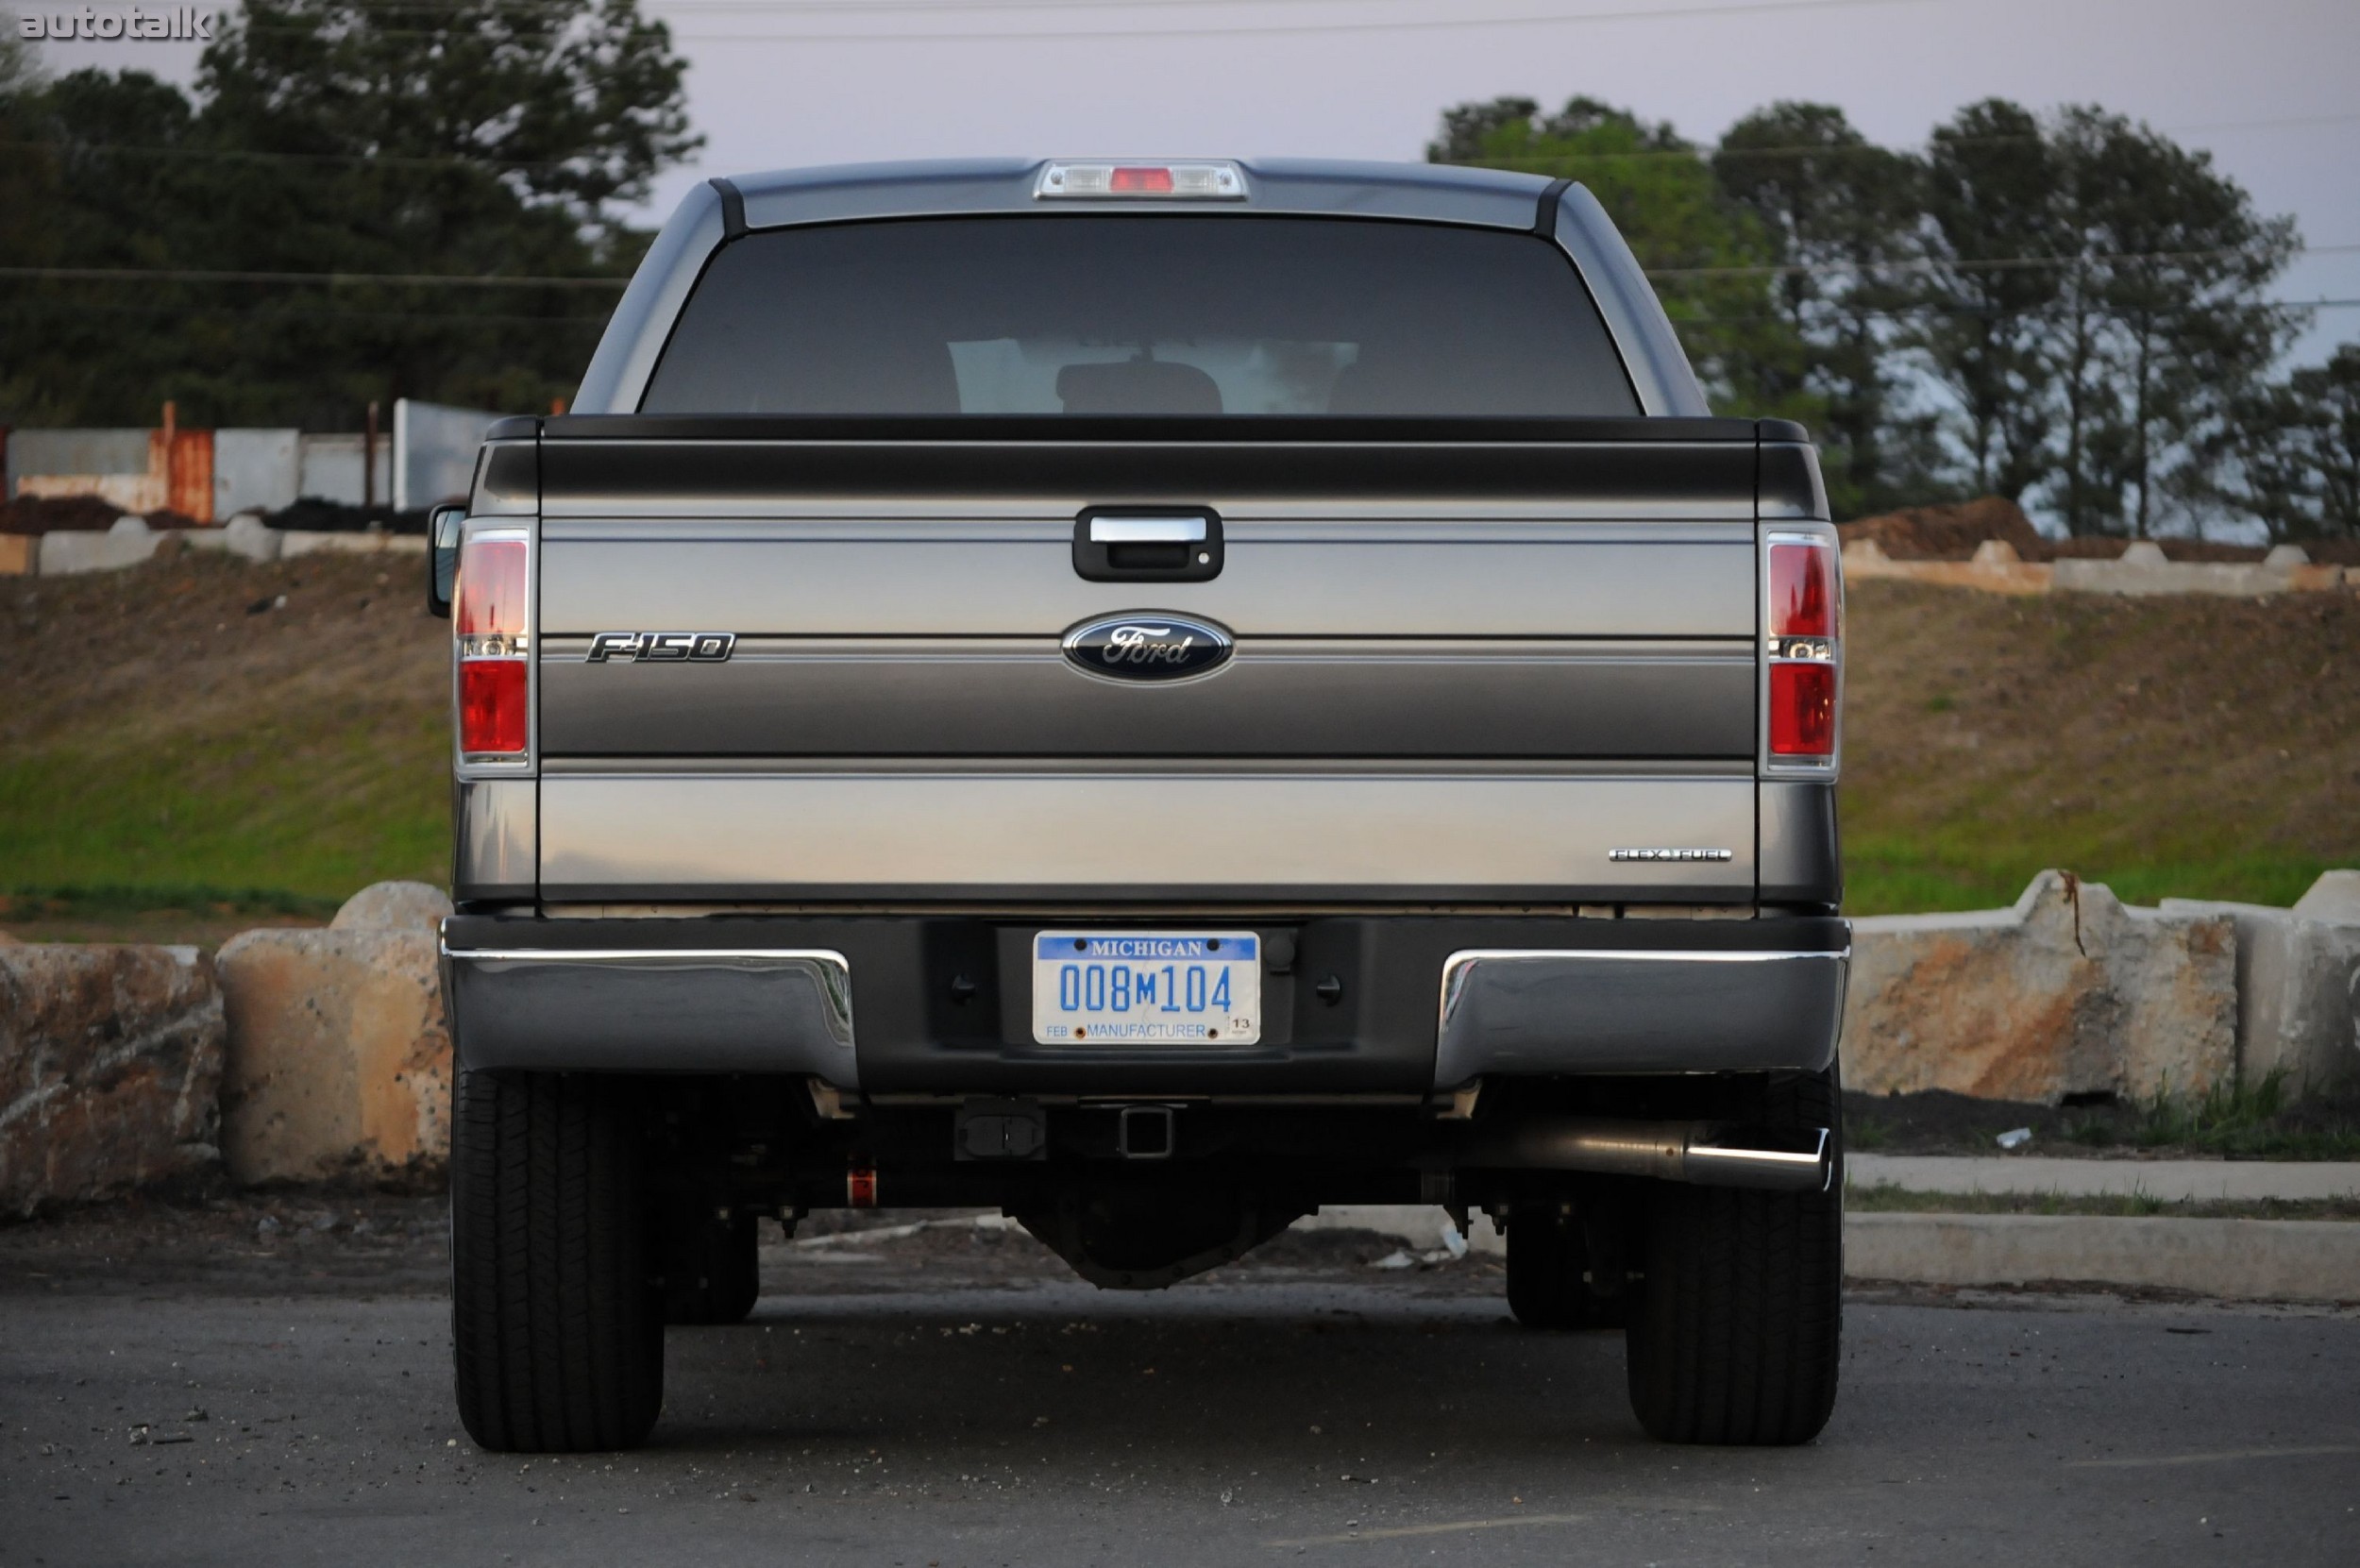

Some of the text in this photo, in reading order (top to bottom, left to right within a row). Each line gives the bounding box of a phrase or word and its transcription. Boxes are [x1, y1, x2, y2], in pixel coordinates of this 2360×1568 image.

[585, 632, 736, 663] F-150
[1103, 626, 1193, 664] Ford
[1613, 849, 1730, 861] FLEX FUEL
[1091, 940, 1202, 956] MICHIGAN
[1046, 1024, 1205, 1037] FEB MANUFACTURER
[1232, 1019, 1250, 1028] 13
